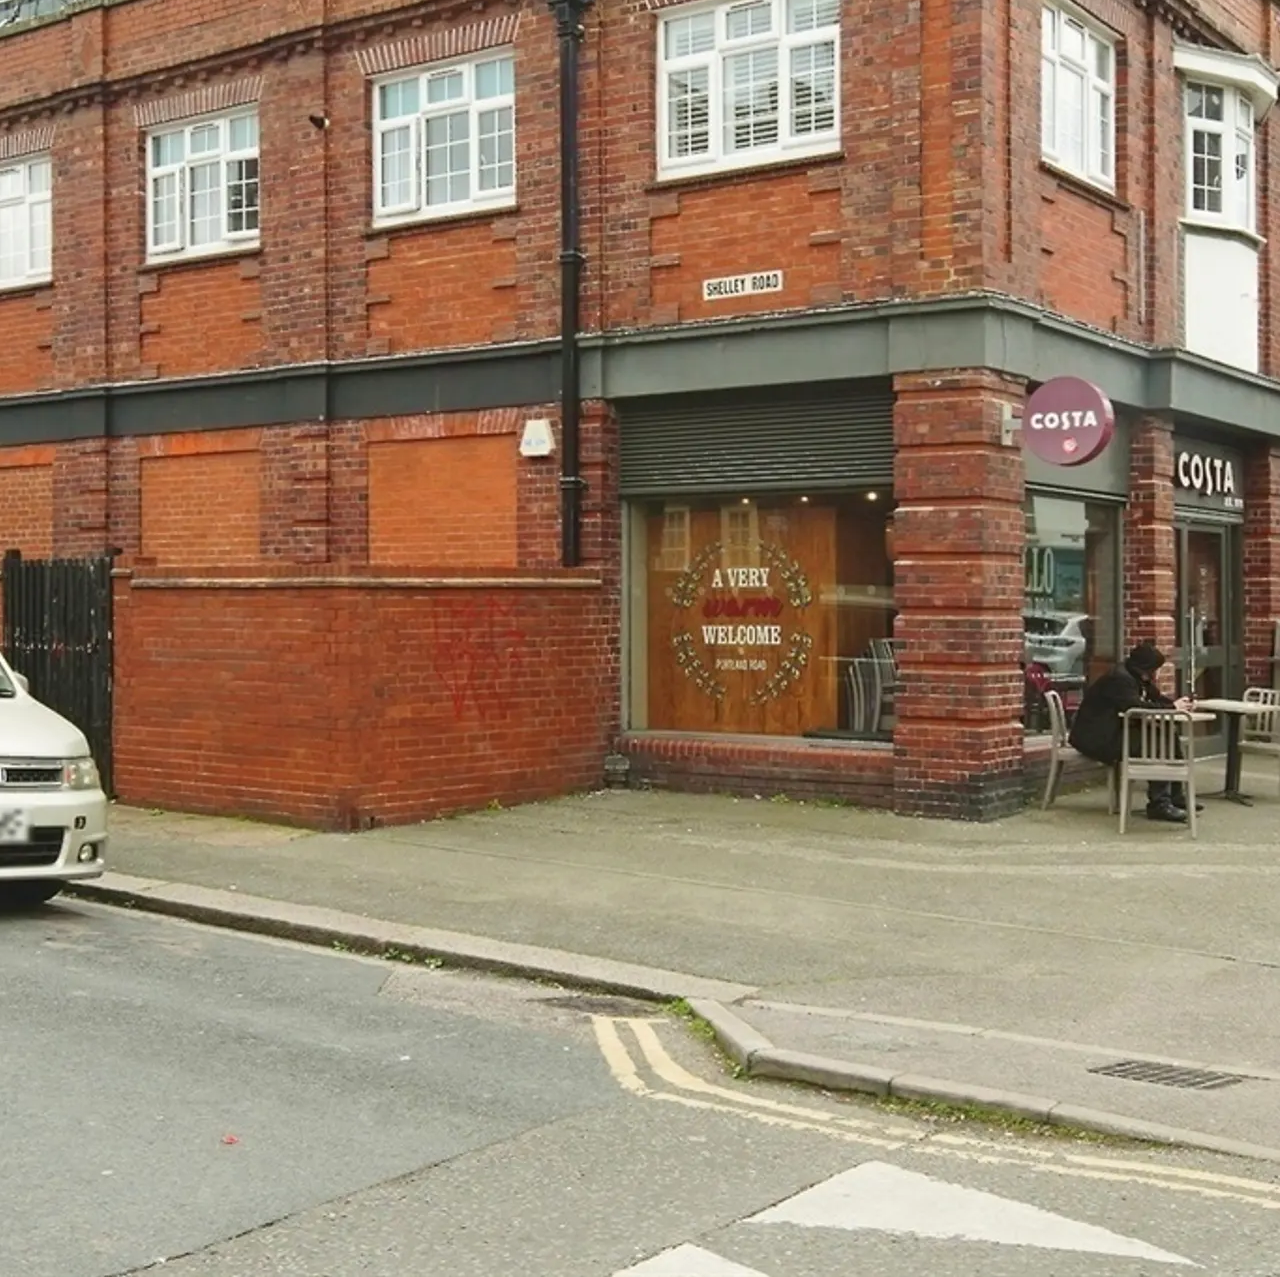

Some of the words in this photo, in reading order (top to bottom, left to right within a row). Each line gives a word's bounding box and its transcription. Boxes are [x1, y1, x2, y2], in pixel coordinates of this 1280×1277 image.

[706, 278, 745, 297] SHELLEY
[751, 273, 778, 290] ROAD
[1030, 409, 1098, 431] COSTA
[1178, 451, 1235, 497] COSTA
[711, 567, 723, 589] A
[726, 567, 770, 588] VERY
[701, 624, 781, 645] WELCOME
